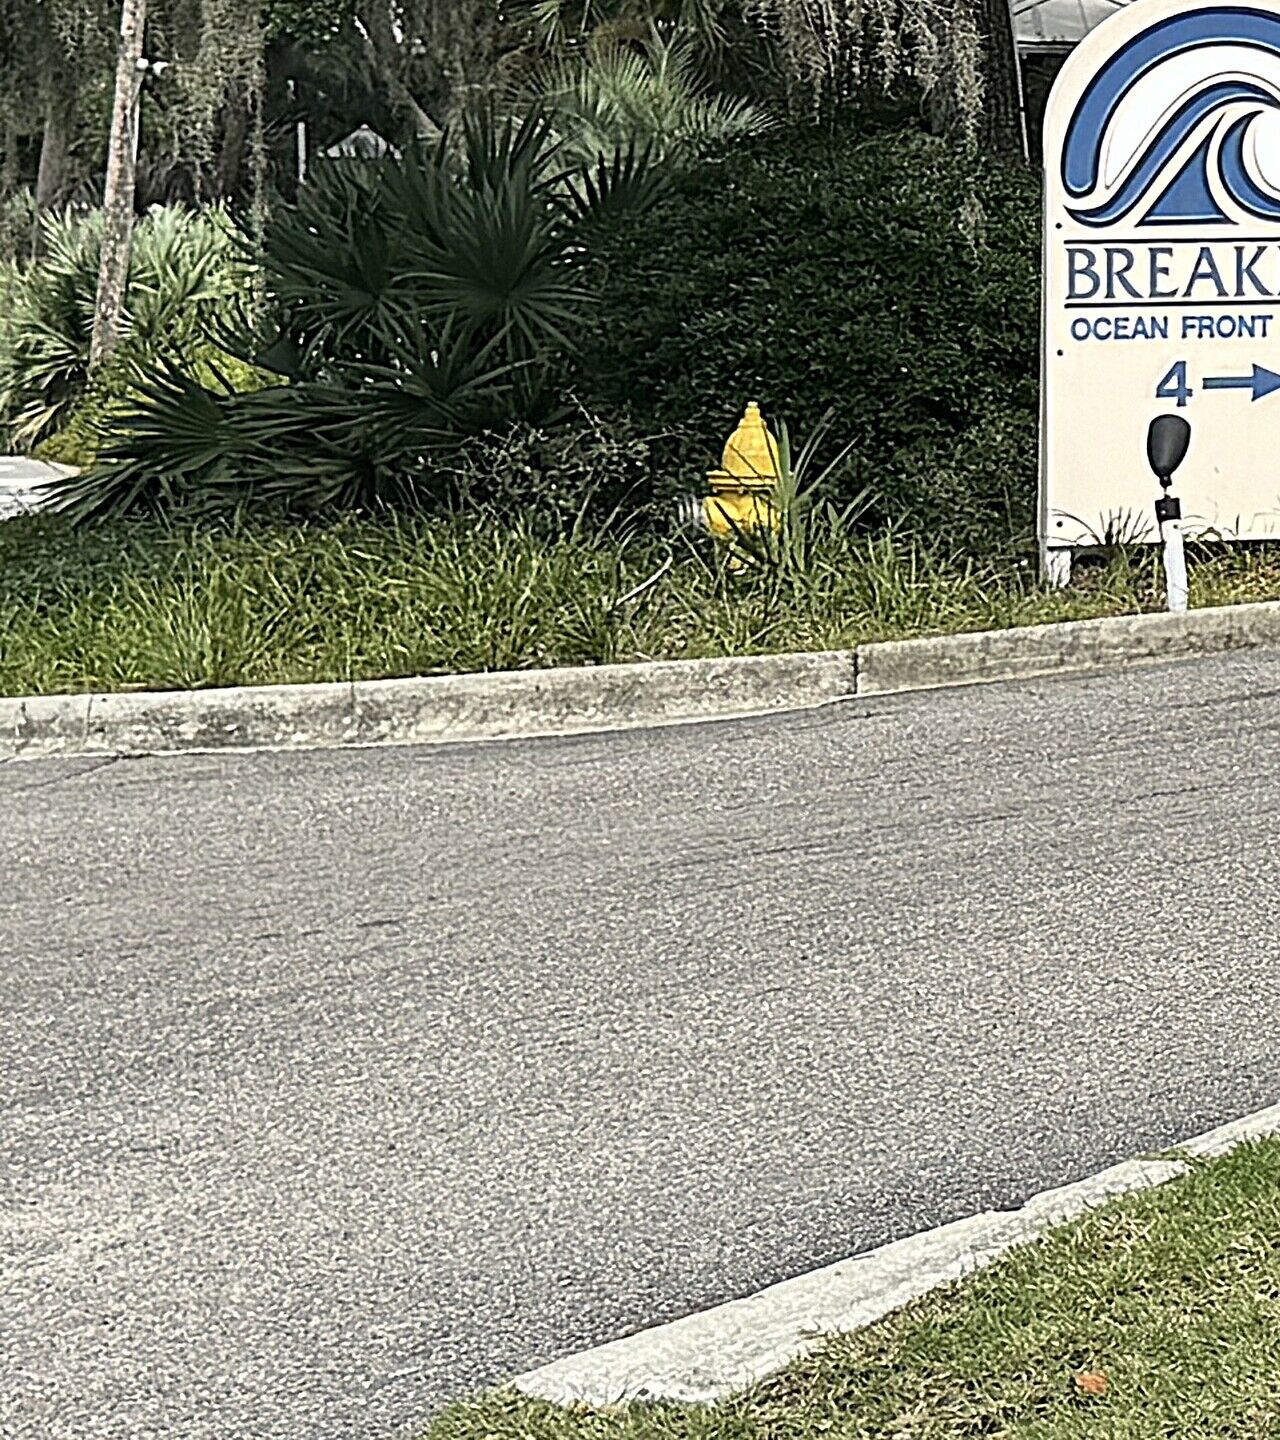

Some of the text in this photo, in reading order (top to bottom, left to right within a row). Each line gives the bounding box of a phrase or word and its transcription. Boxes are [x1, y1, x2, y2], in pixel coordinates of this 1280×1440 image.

[1070, 316, 1168, 341] OCEAN
[1181, 314, 1273, 338] FRONT
[1155, 360, 1193, 408] 4
